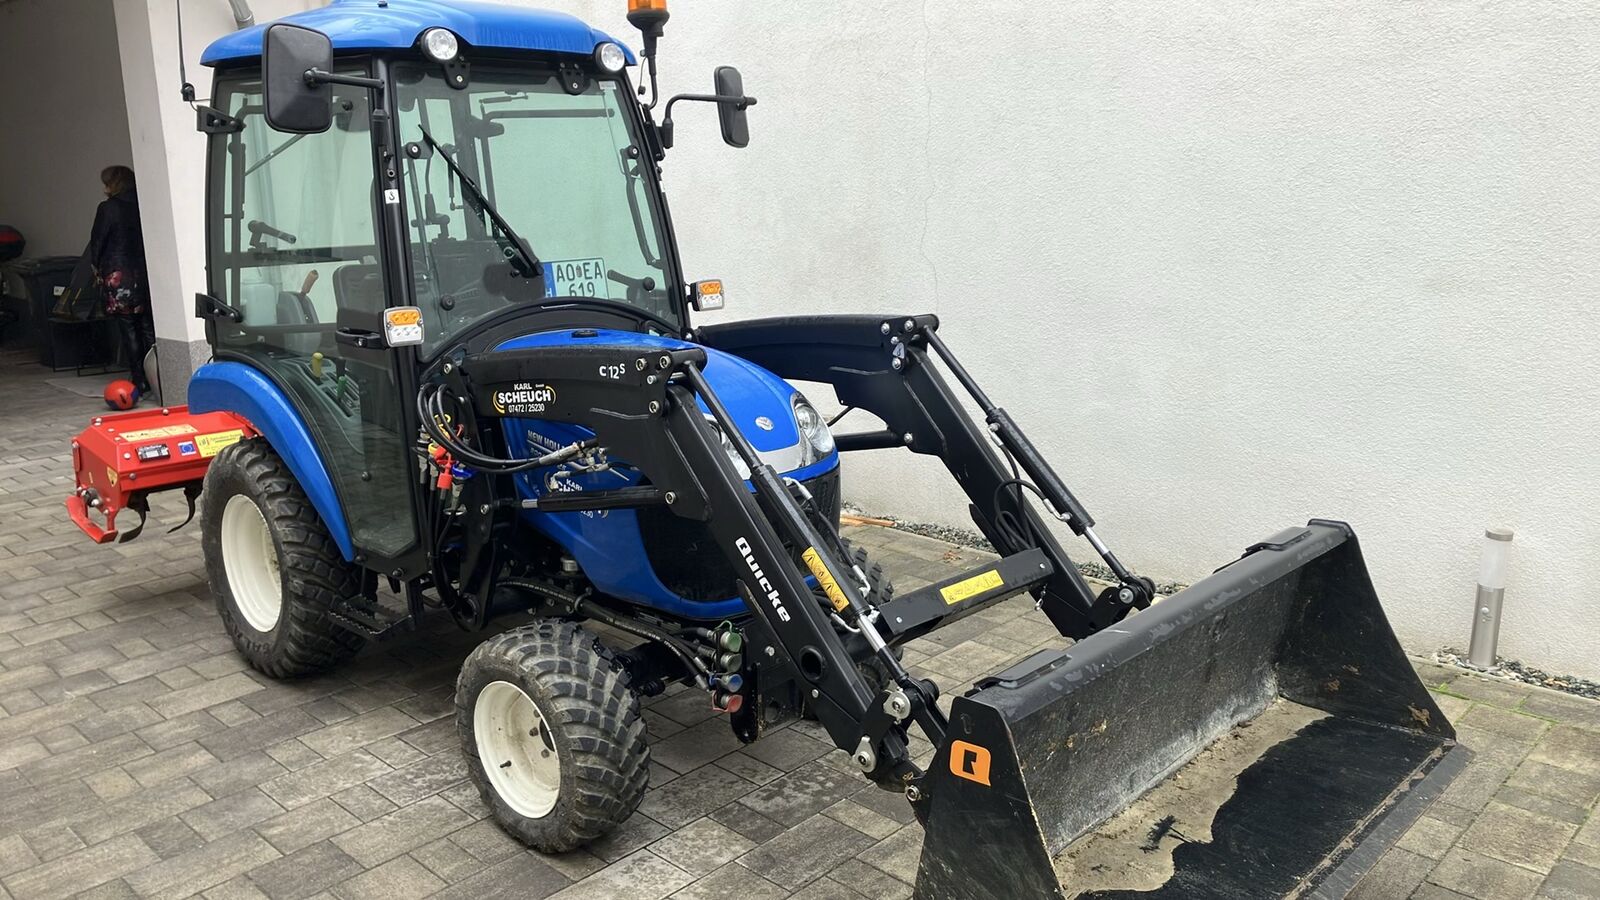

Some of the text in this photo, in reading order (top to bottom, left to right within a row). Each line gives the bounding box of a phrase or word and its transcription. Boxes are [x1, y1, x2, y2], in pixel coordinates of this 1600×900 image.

[557, 261, 603, 283] AO EA
[569, 282, 595, 297] 619
[513, 382, 533, 391] KARL
[498, 389, 552, 404] SCHEUCH
[508, 404, 525, 413] 07472
[528, 403, 545, 412] 25230
[527, 429, 543, 444] NEW
[735, 536, 791, 622] Quicke
